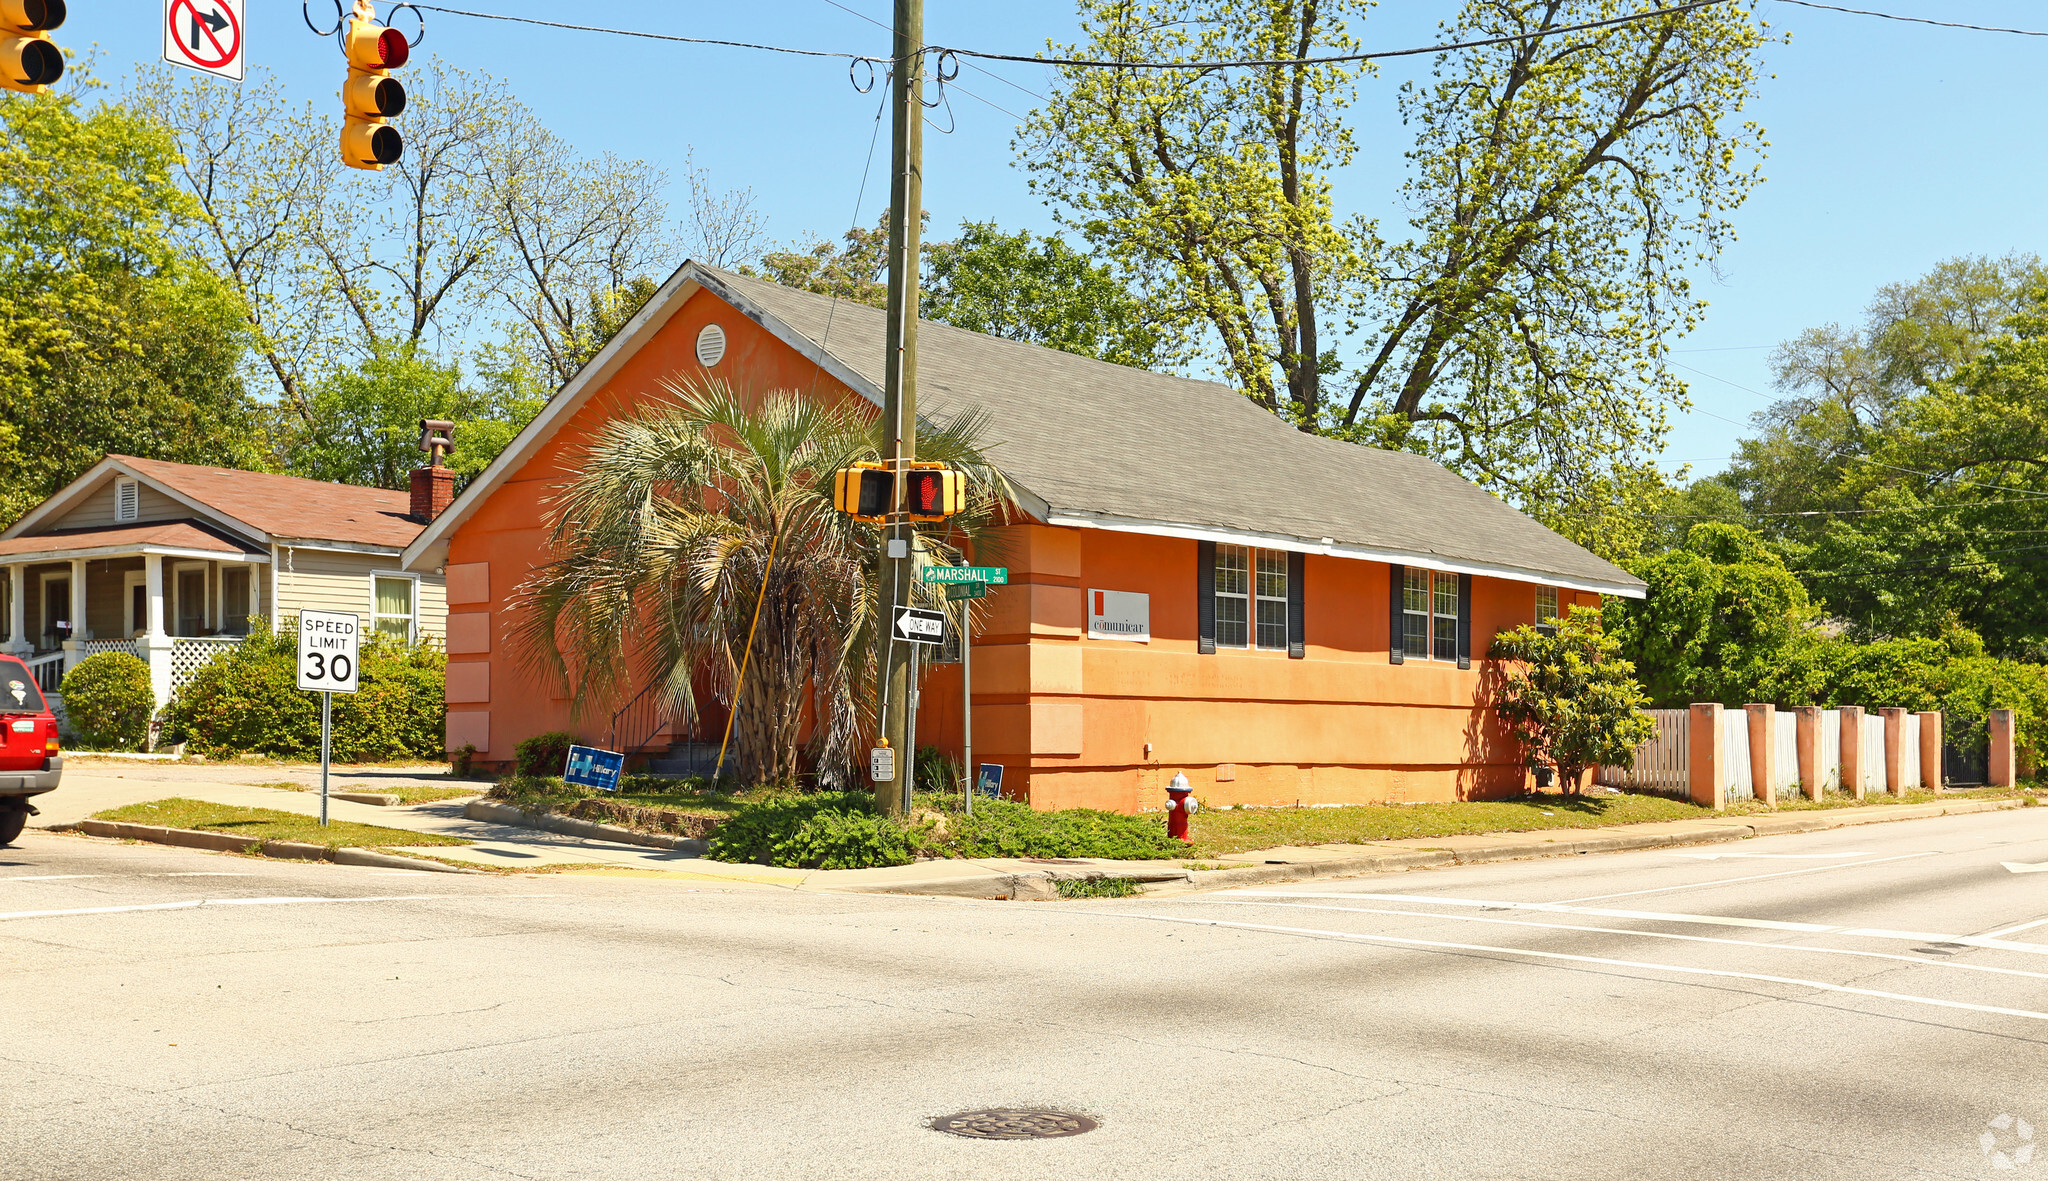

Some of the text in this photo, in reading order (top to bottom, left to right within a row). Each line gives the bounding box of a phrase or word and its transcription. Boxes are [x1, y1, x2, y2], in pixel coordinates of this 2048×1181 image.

[936, 568, 989, 582] MARSHALL
[305, 619, 354, 634] SPEED
[909, 618, 940, 634] ONE WAY
[310, 636, 348, 650] LIMIT
[305, 652, 351, 682] 30
[592, 764, 617, 777] Hillary
